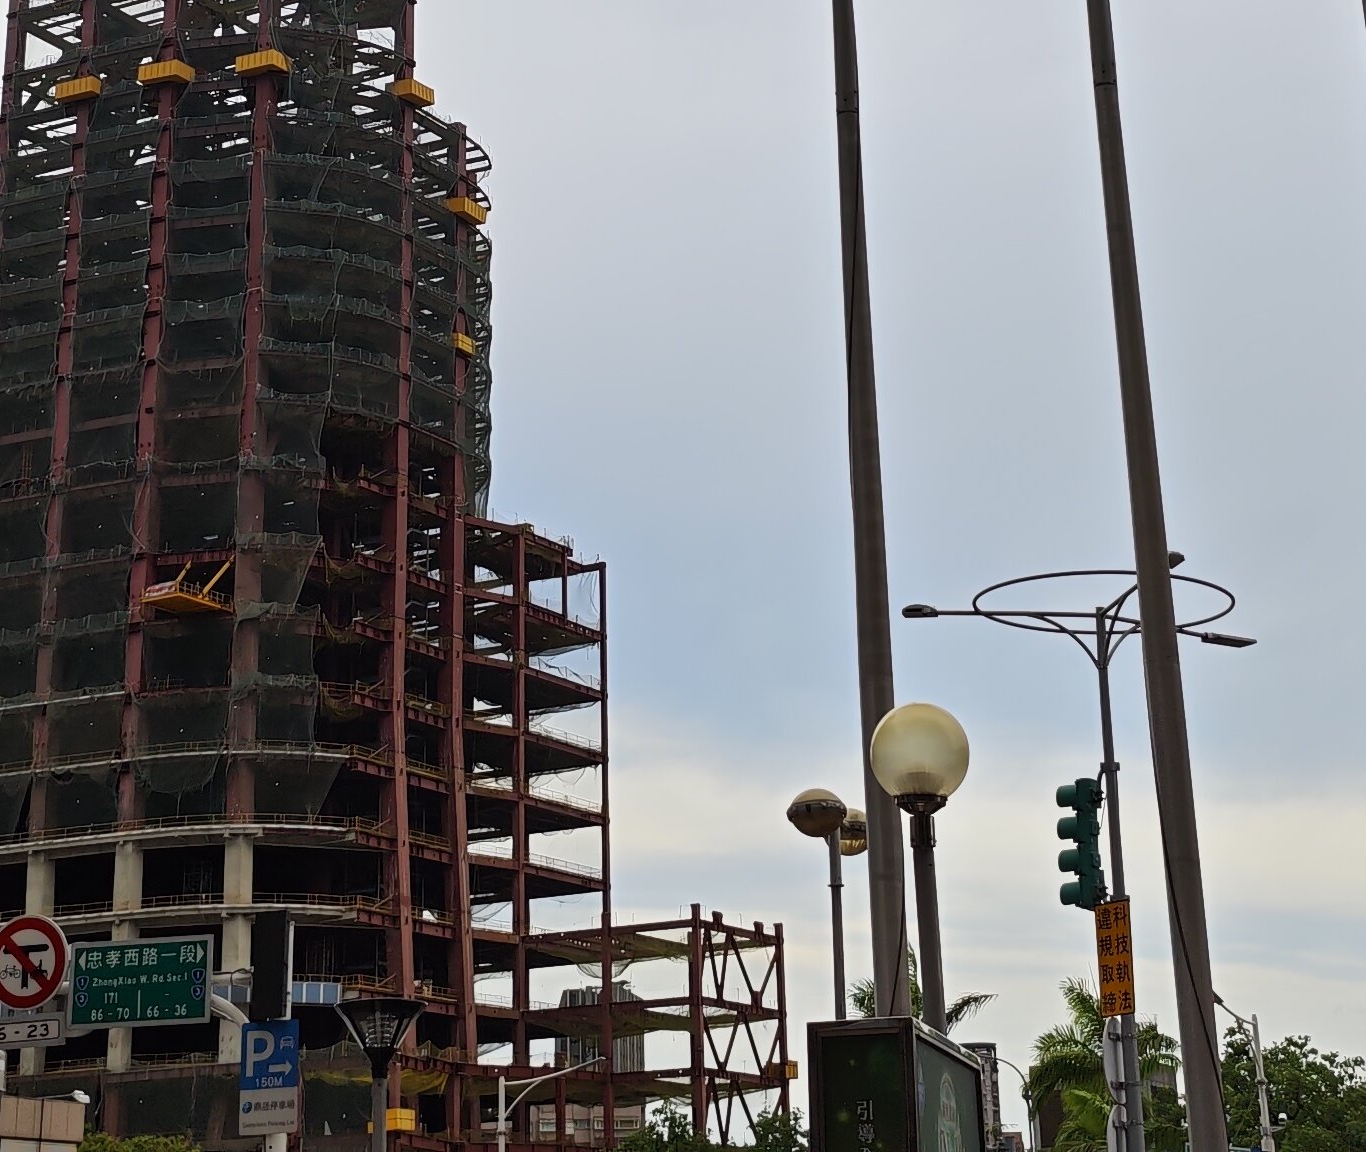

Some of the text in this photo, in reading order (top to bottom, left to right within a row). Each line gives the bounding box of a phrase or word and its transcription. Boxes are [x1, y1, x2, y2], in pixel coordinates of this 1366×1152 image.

[86, 945, 196, 970] 忠孝西路一段
[1097, 909, 1117, 1014] 違規取締
[1113, 904, 1132, 1011] 科技執法
[104, 991, 118, 1004] 171
[245, 1030, 275, 1078] P
[255, 1075, 283, 1088] 150M
[856, 1099, 876, 1152] 引導
